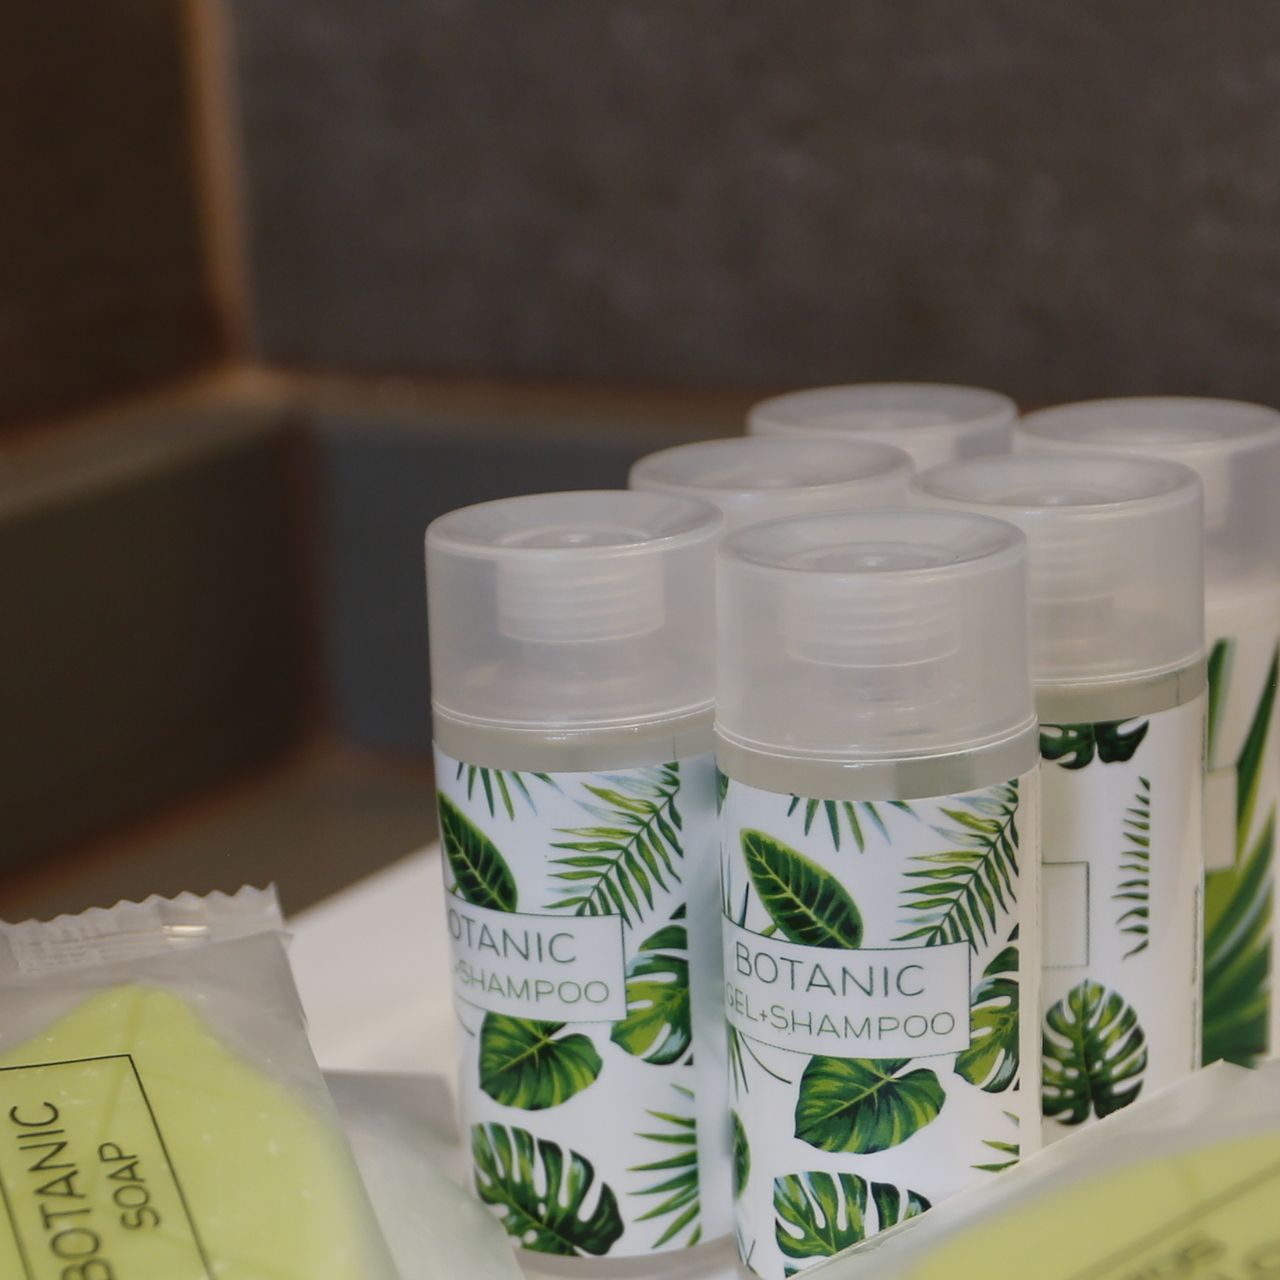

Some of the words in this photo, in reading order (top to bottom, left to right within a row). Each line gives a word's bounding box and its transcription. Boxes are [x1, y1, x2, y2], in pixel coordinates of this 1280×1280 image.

[448, 908, 576, 964] OTANIC
[455, 959, 610, 1004] SHAMPOO
[735, 941, 925, 998] BOTANIC
[725, 981, 956, 1041] GEL+SHAMPOO
[97, 1141, 161, 1231] SOAP
